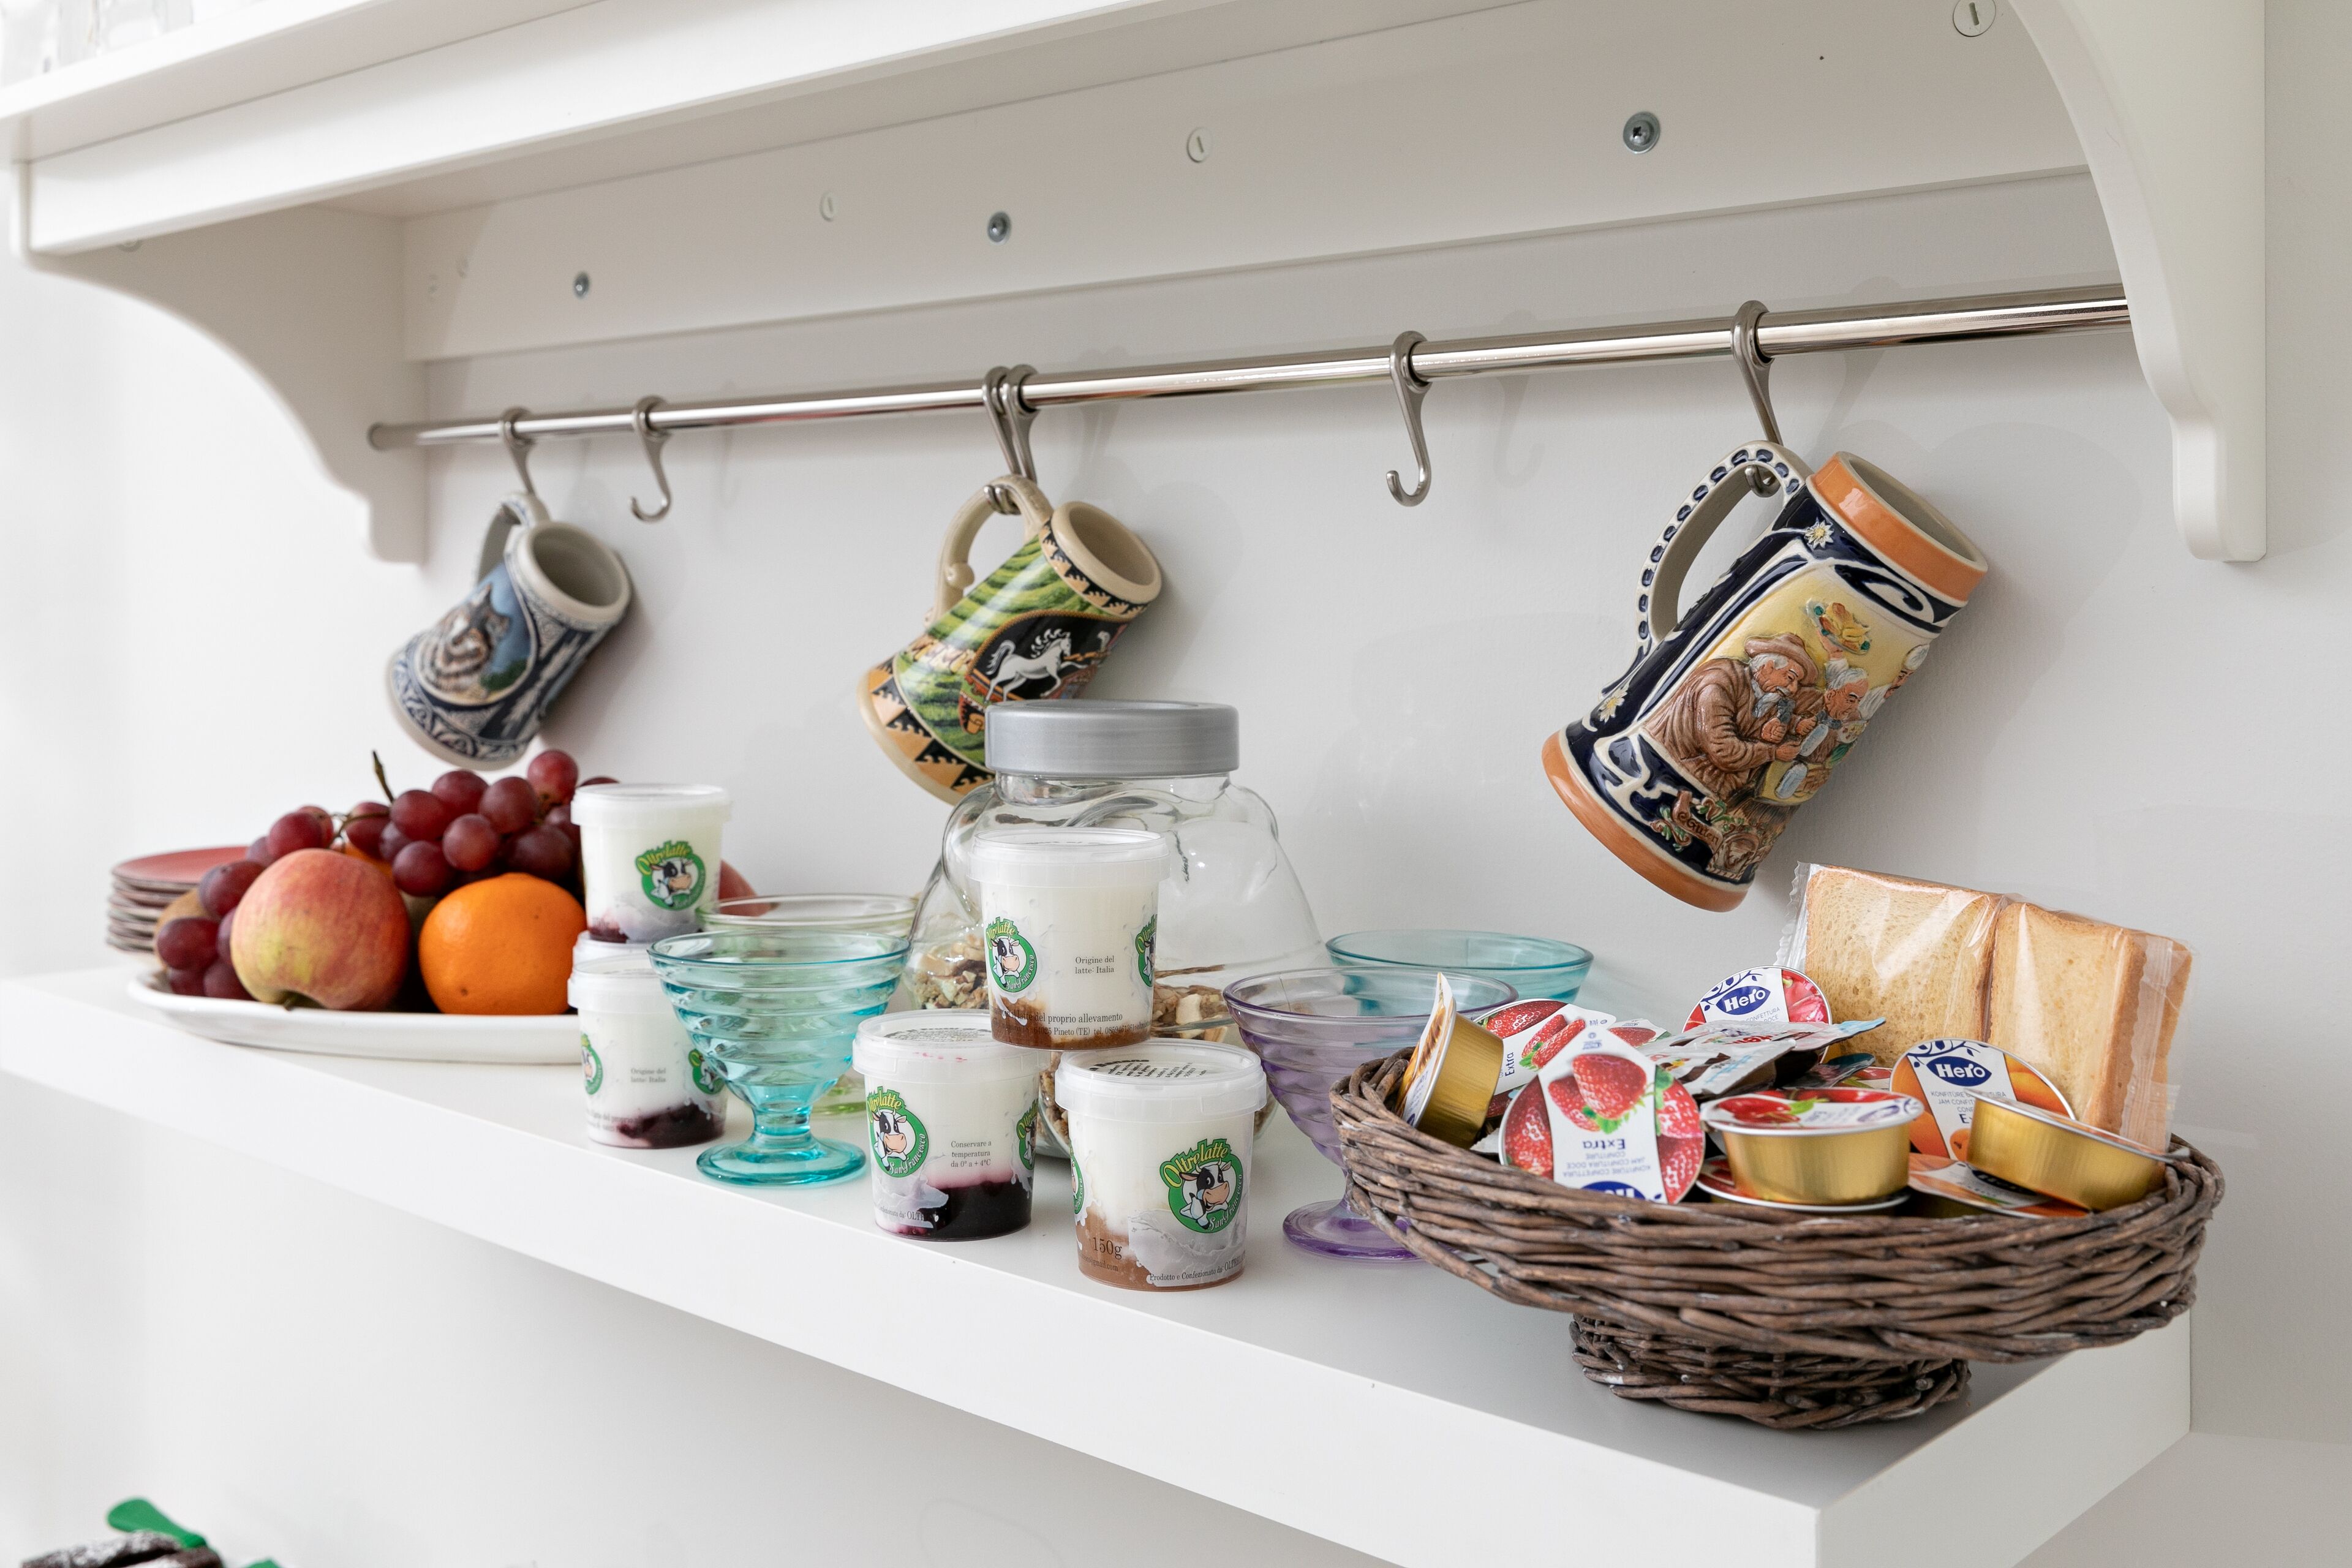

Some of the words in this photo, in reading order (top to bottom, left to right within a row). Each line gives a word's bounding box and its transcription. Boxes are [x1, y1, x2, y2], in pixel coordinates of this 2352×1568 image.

[1075, 956, 1103, 965] Origine
[1724, 988, 1766, 1012] Hero
[1035, 1012, 1046, 1022] del
[1048, 1013, 1076, 1025] proprio
[1079, 1012, 1123, 1023] allevamento
[1076, 1026, 1090, 1036] (TE)
[1093, 1027, 1104, 1035] tel.
[1504, 1051, 1515, 1077] Extra
[1936, 1063, 1986, 1078] Hero
[630, 1068, 655, 1076] Origine
[1583, 1139, 1626, 1150] Extra
[1164, 1142, 1228, 1188] Oltrelatte
[1093, 1237, 1123, 1260] 150g
[1182, 1269, 1216, 1280] Confezionato
